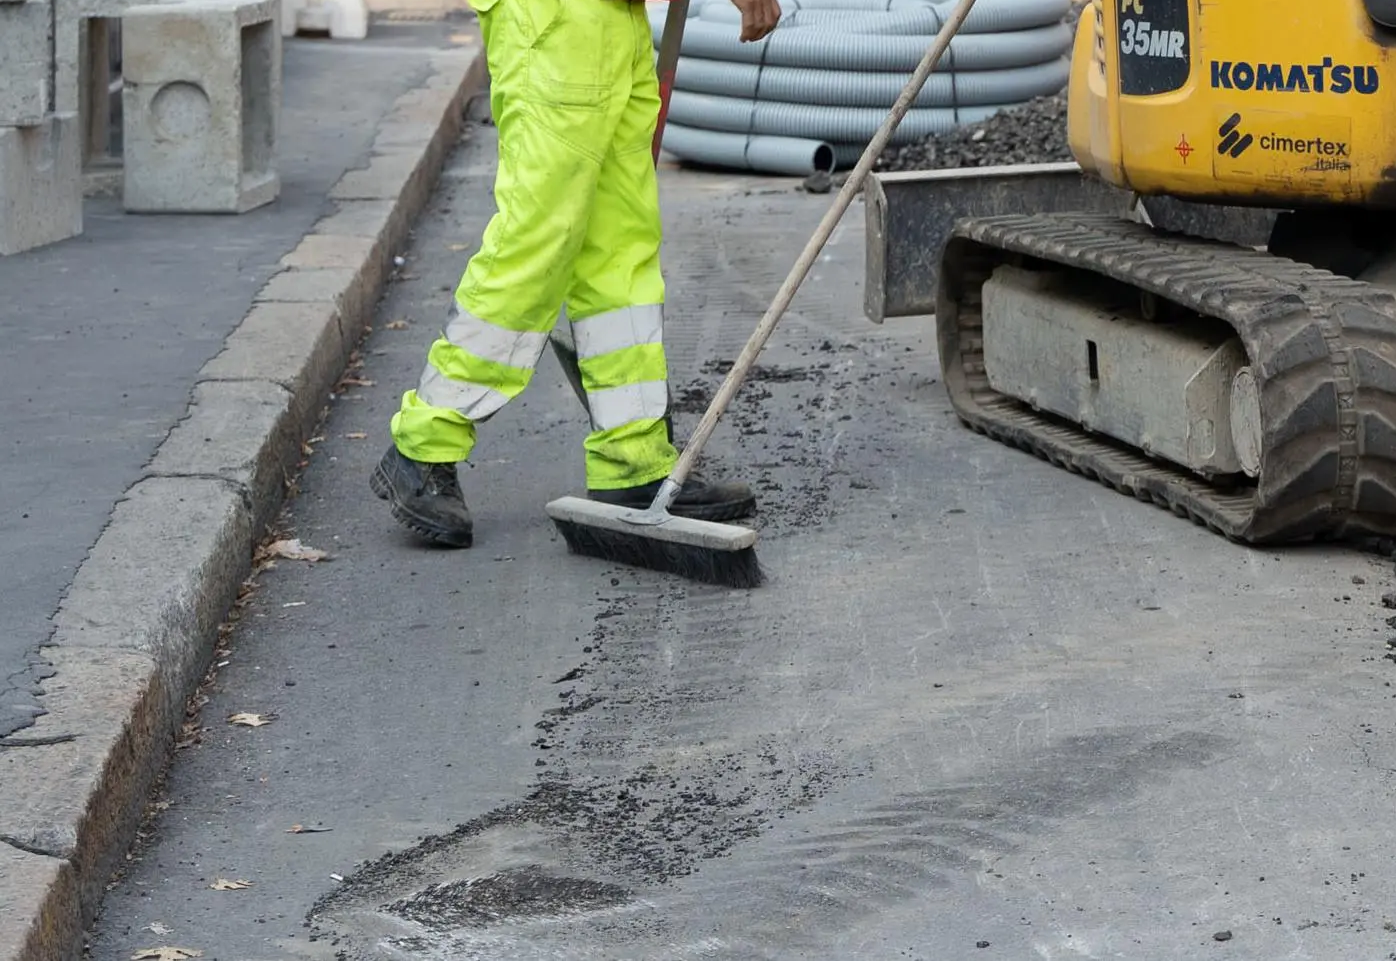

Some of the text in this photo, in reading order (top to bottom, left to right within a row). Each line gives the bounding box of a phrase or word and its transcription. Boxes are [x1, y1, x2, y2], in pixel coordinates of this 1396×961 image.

[1121, 18, 1185, 58] 35MR
[1211, 57, 1379, 94] KOMATSU
[1260, 133, 1347, 156] cimertex
[1316, 157, 1348, 171] italia
